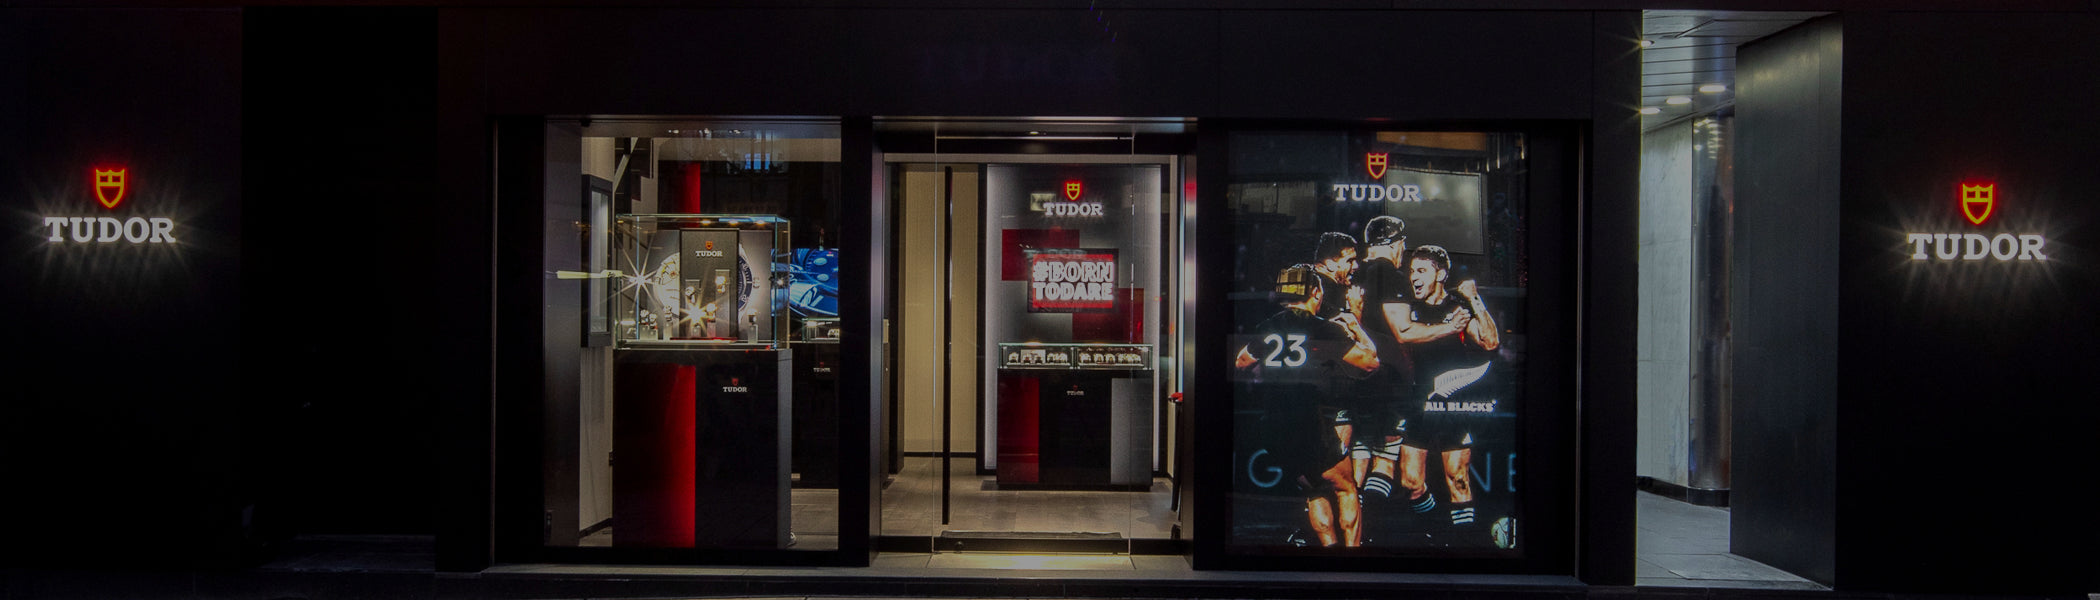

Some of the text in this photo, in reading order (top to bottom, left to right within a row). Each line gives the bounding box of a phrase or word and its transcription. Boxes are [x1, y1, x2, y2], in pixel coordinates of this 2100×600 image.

[1333, 184, 1422, 202] TUDOR
[1043, 203, 1103, 216] TUDOR
[45, 217, 175, 243] TUDOR
[1908, 233, 2047, 260] TUDOR
[1033, 261, 1113, 281] #BORN
[1033, 282, 1113, 301] TODARE
[1263, 333, 1308, 367] 23
[1424, 401, 1494, 412] ALL BLACKS
